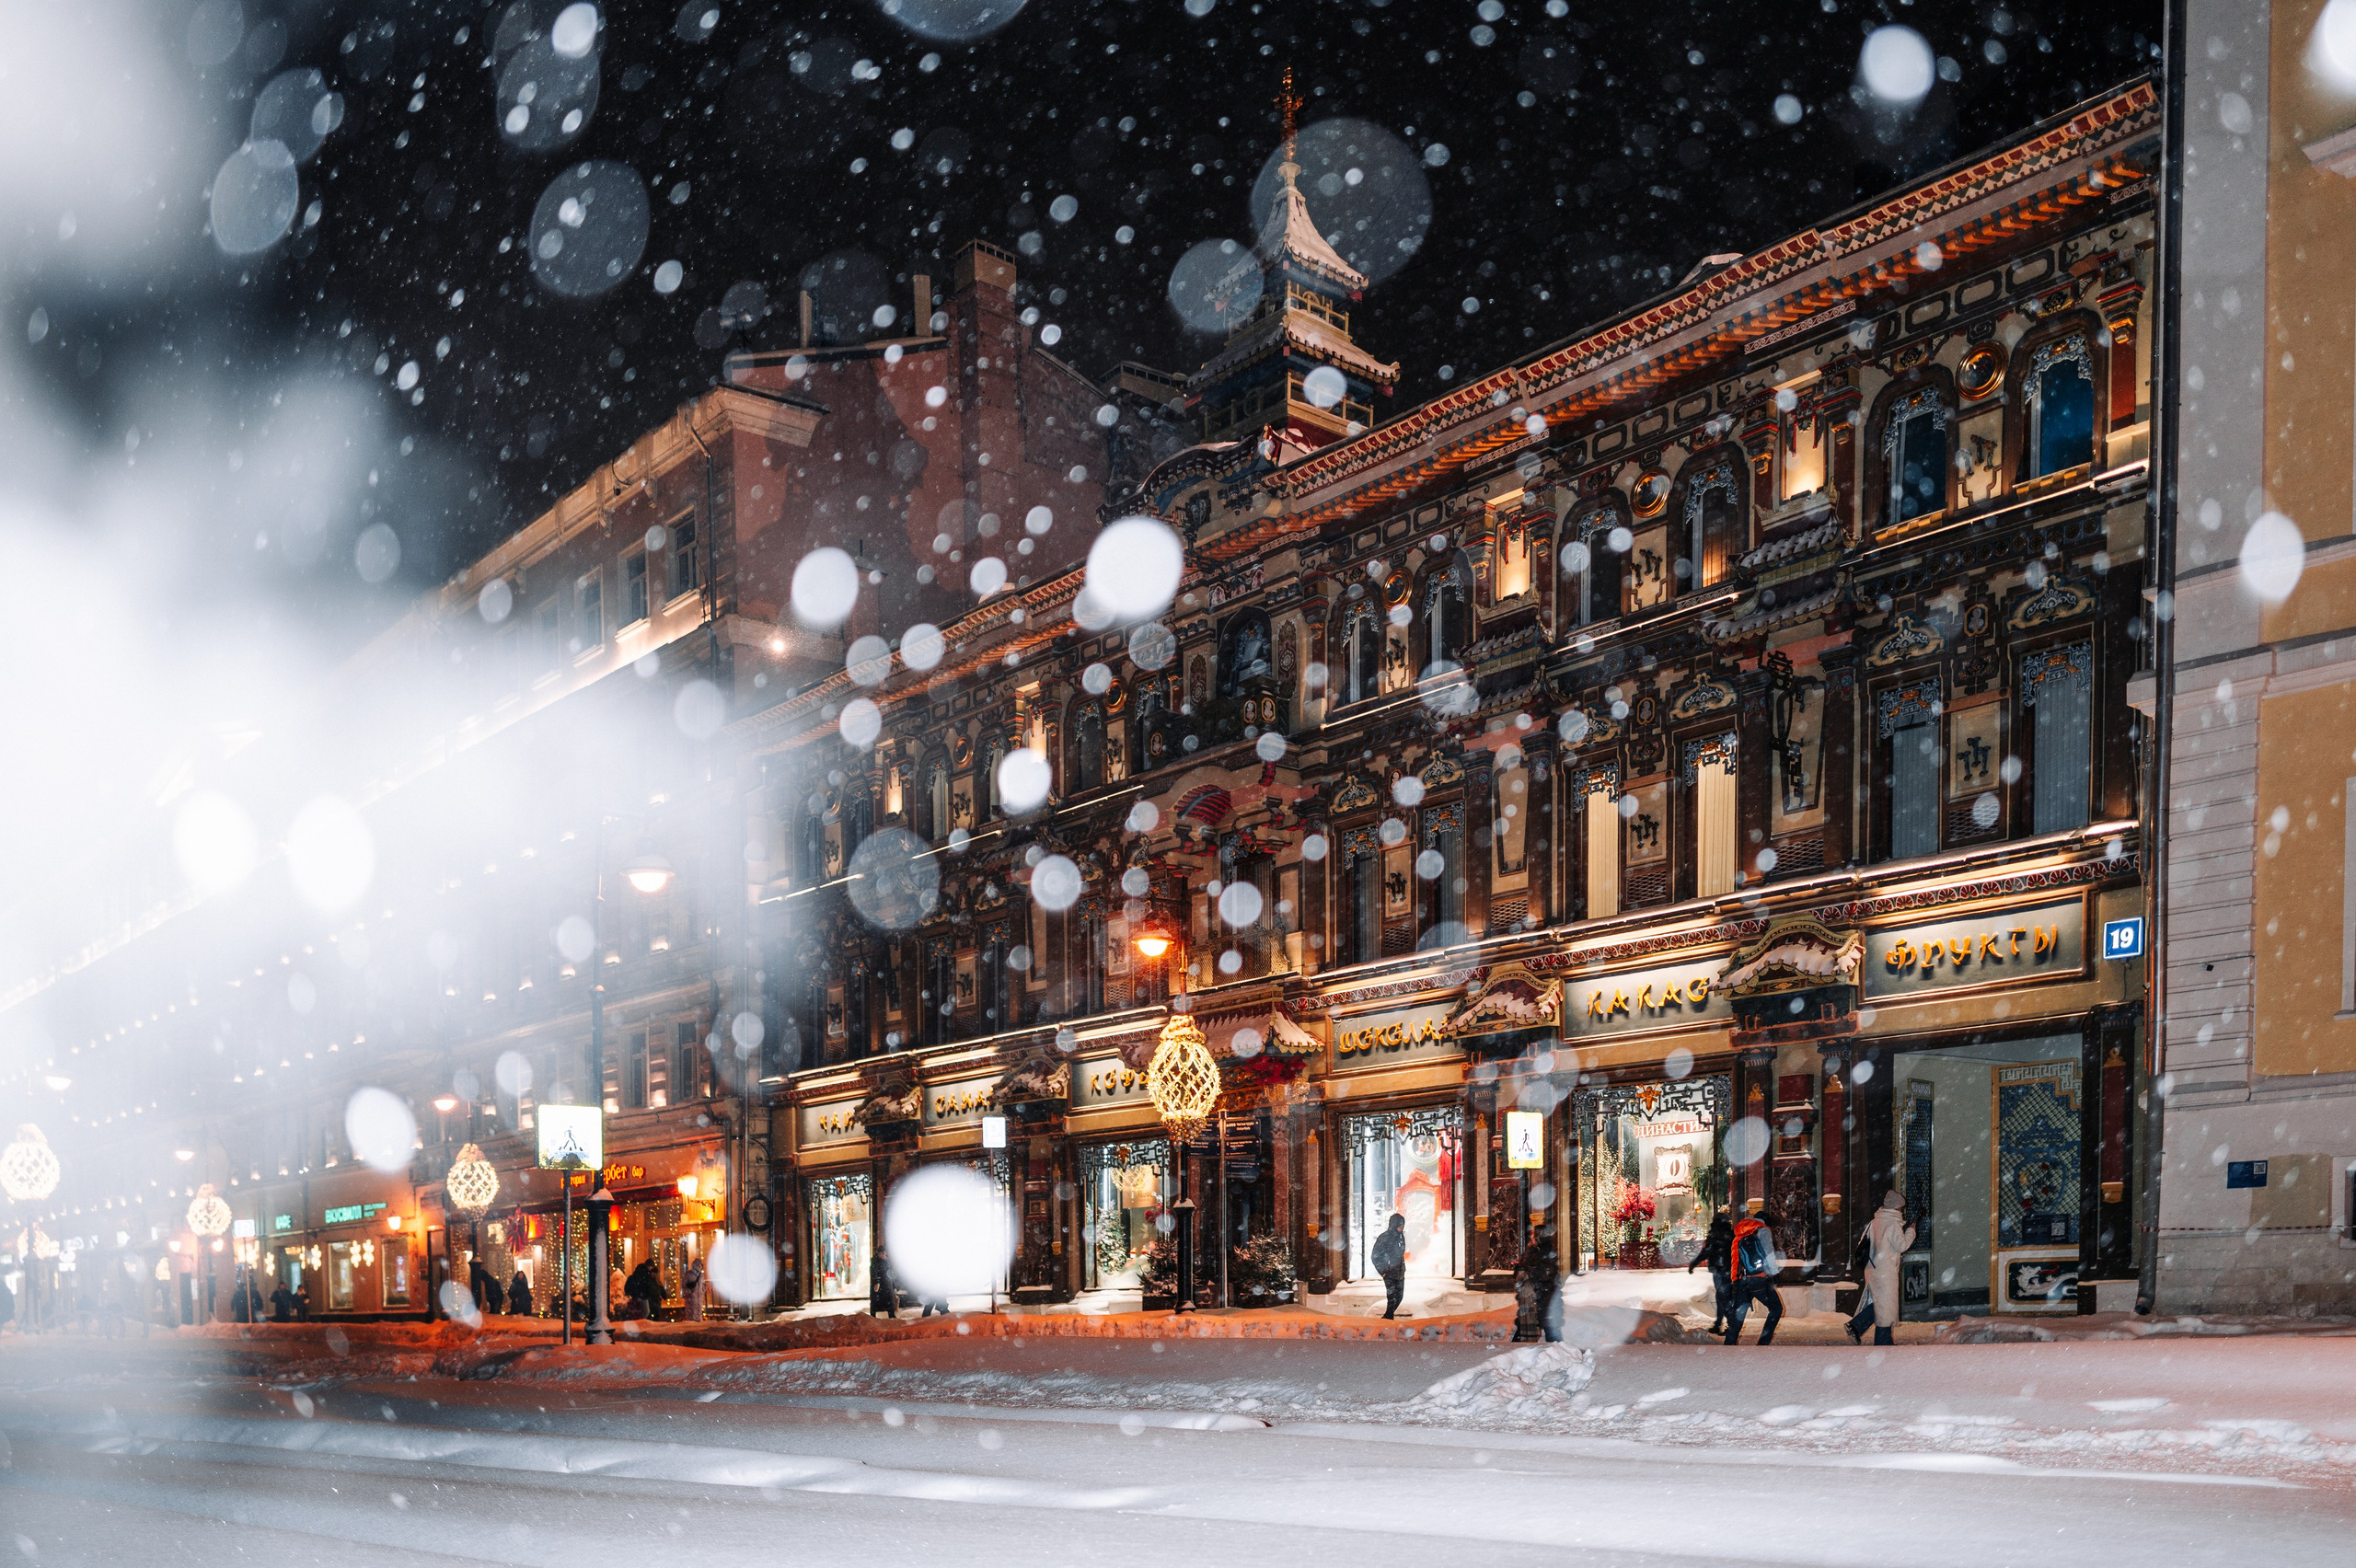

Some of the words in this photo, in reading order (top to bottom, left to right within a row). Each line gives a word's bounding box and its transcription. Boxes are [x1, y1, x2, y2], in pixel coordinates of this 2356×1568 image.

[1886, 924, 2058, 969] ФРУКТЫ
[2109, 928, 2134, 950] 19
[1587, 976, 1710, 1017] КАКАО
